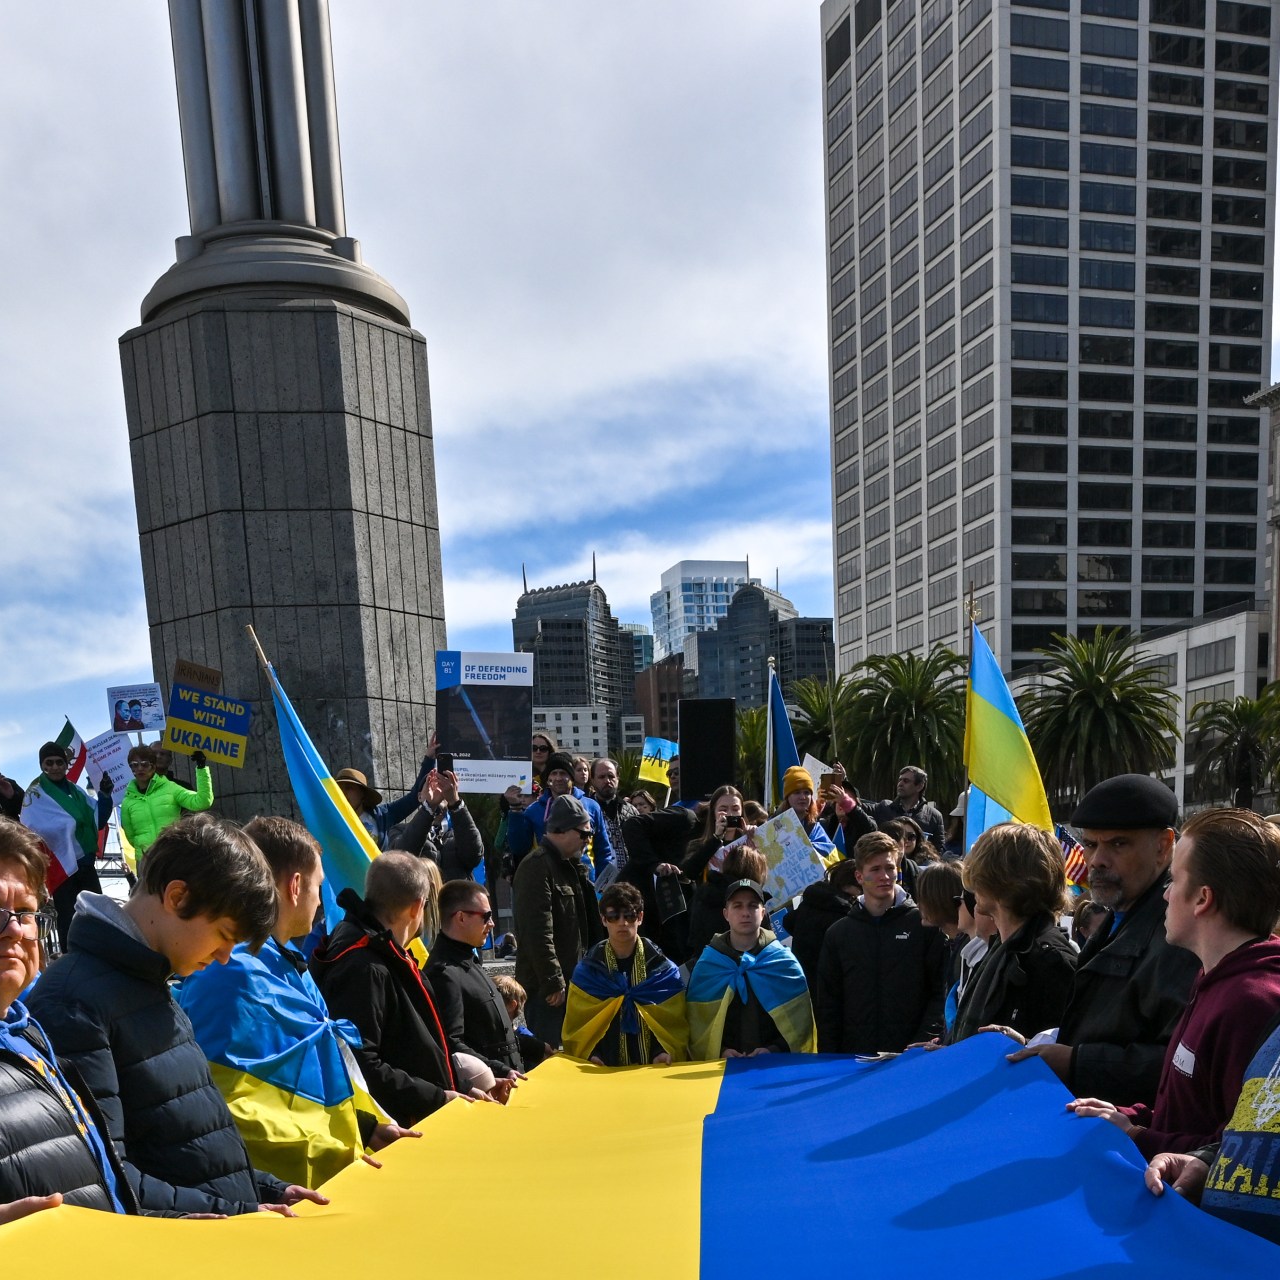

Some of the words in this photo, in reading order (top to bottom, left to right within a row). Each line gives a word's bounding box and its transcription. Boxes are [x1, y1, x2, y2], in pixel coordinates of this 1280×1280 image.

[478, 665, 528, 674] DEFENDING
[464, 673, 506, 681] FREEDOM
[179, 688, 200, 704] WE
[203, 695, 246, 717] STAND
[192, 708, 226, 728] WITH
[170, 726, 240, 759] UKRAINE
[108, 762, 125, 774] OMAN
[773, 919, 785, 933] DAY
